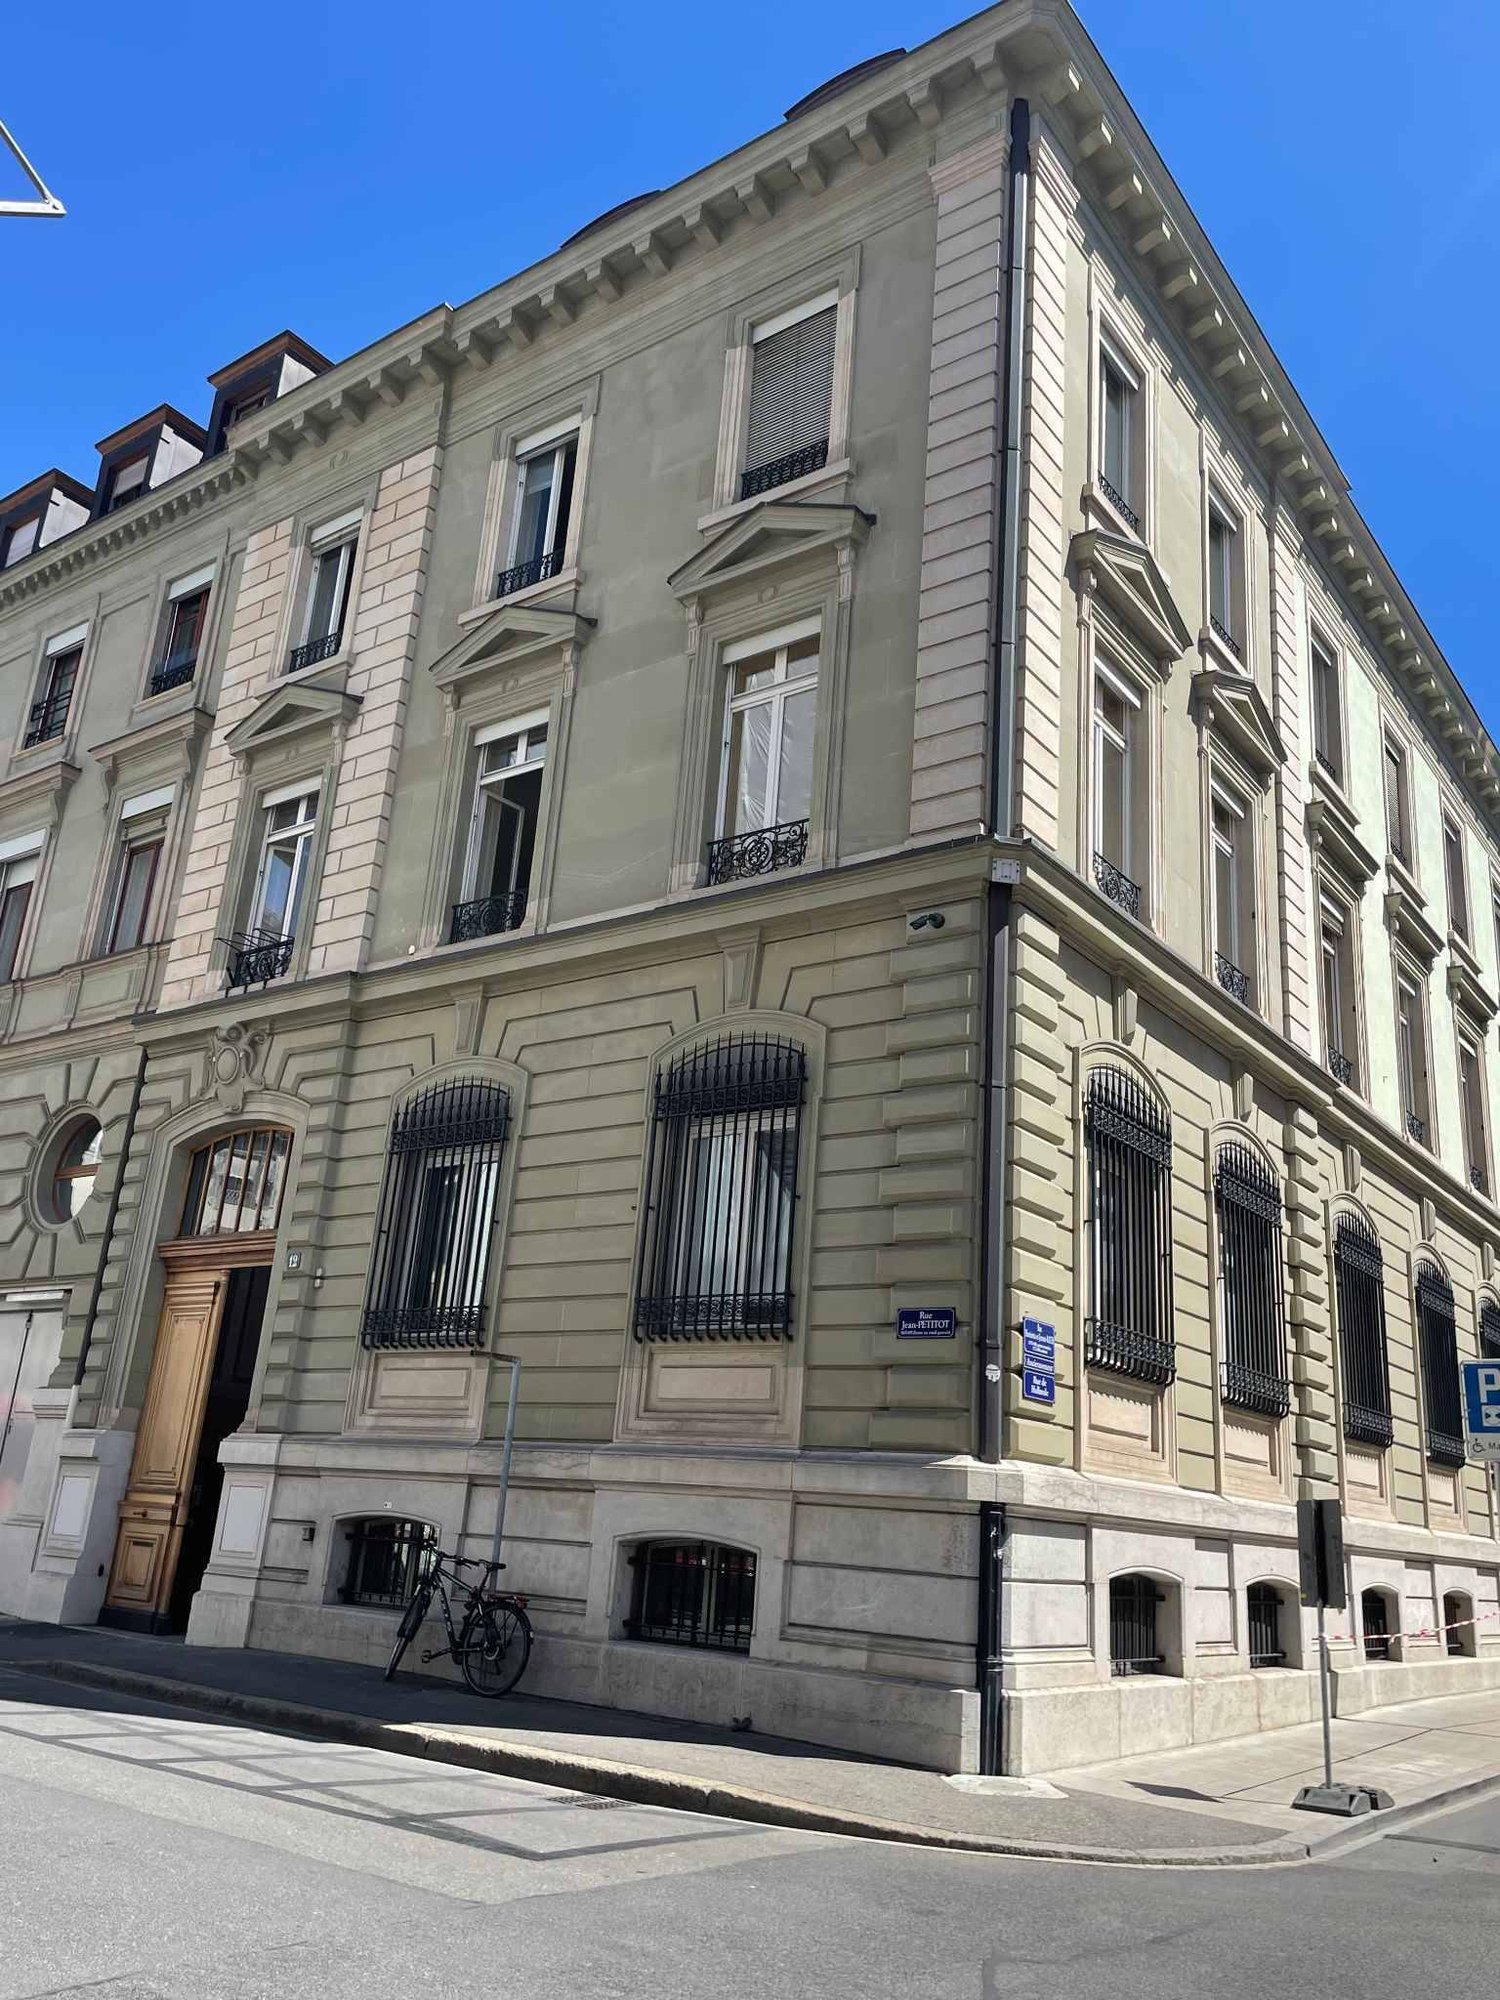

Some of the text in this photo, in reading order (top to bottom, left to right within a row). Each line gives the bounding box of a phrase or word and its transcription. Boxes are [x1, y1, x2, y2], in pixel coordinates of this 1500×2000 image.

[919, 1311, 933, 1319] Rue
[901, 1320, 950, 1330] Jean-PETITOT
[1477, 1368, 1500, 1404] P
